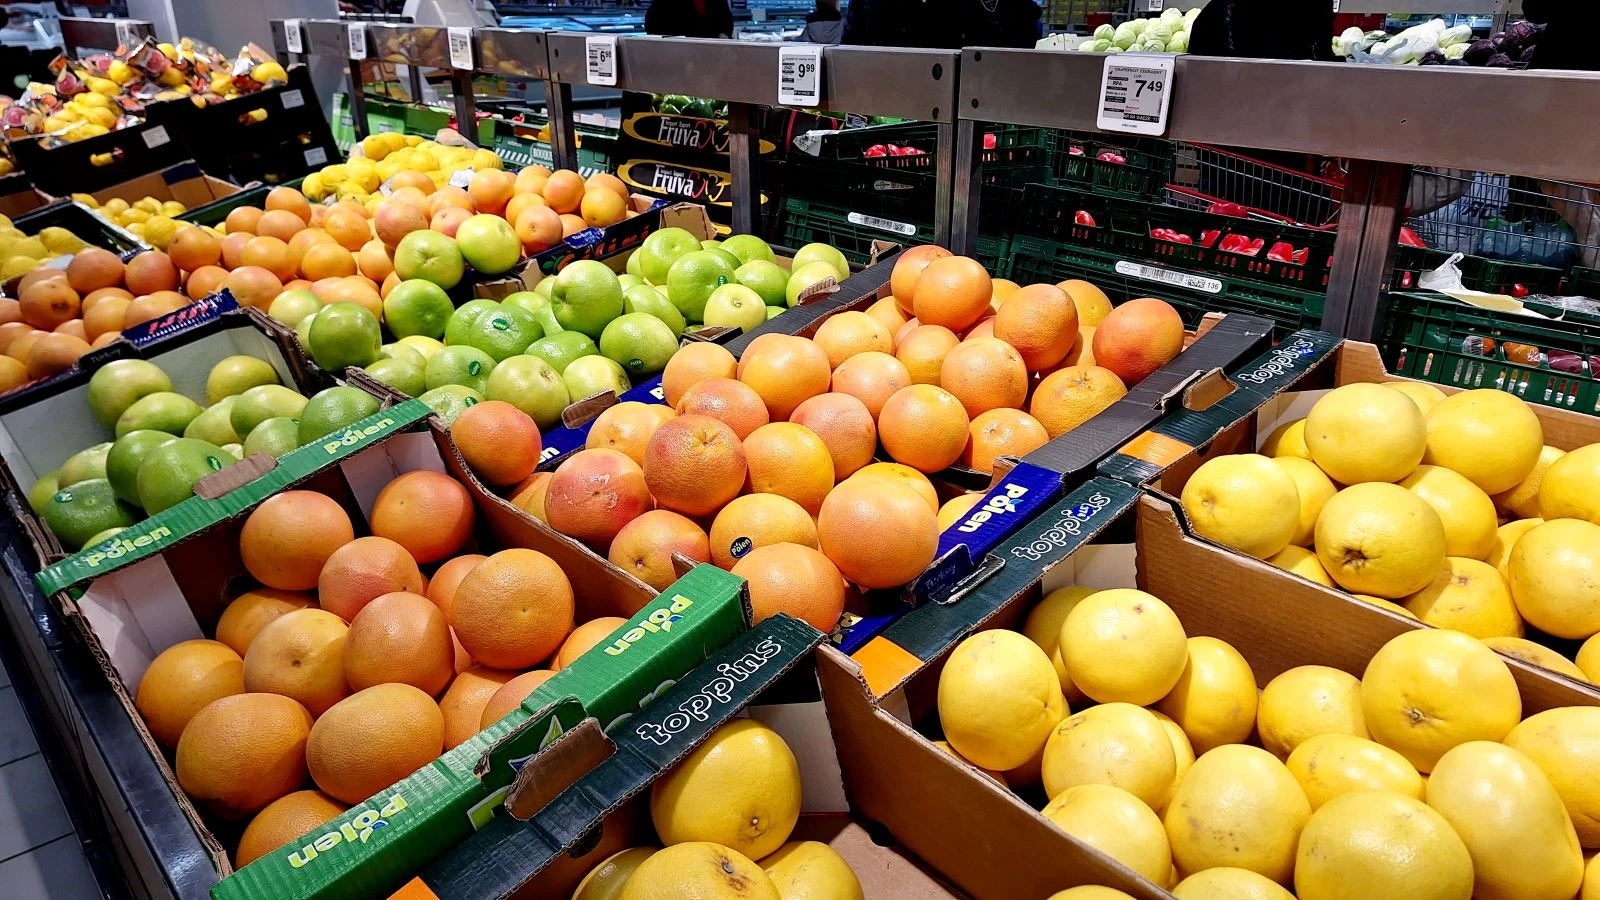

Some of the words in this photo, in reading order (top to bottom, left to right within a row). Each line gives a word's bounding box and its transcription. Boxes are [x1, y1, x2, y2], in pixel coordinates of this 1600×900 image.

[657, 116, 700, 147] Fruva
[651, 164, 694, 197] Fruva
[1207, 282, 1219, 290] 136
[1237, 338, 1314, 384] toppins
[1010, 492, 1111, 561] toppins
[636, 636, 782, 746] toppins
